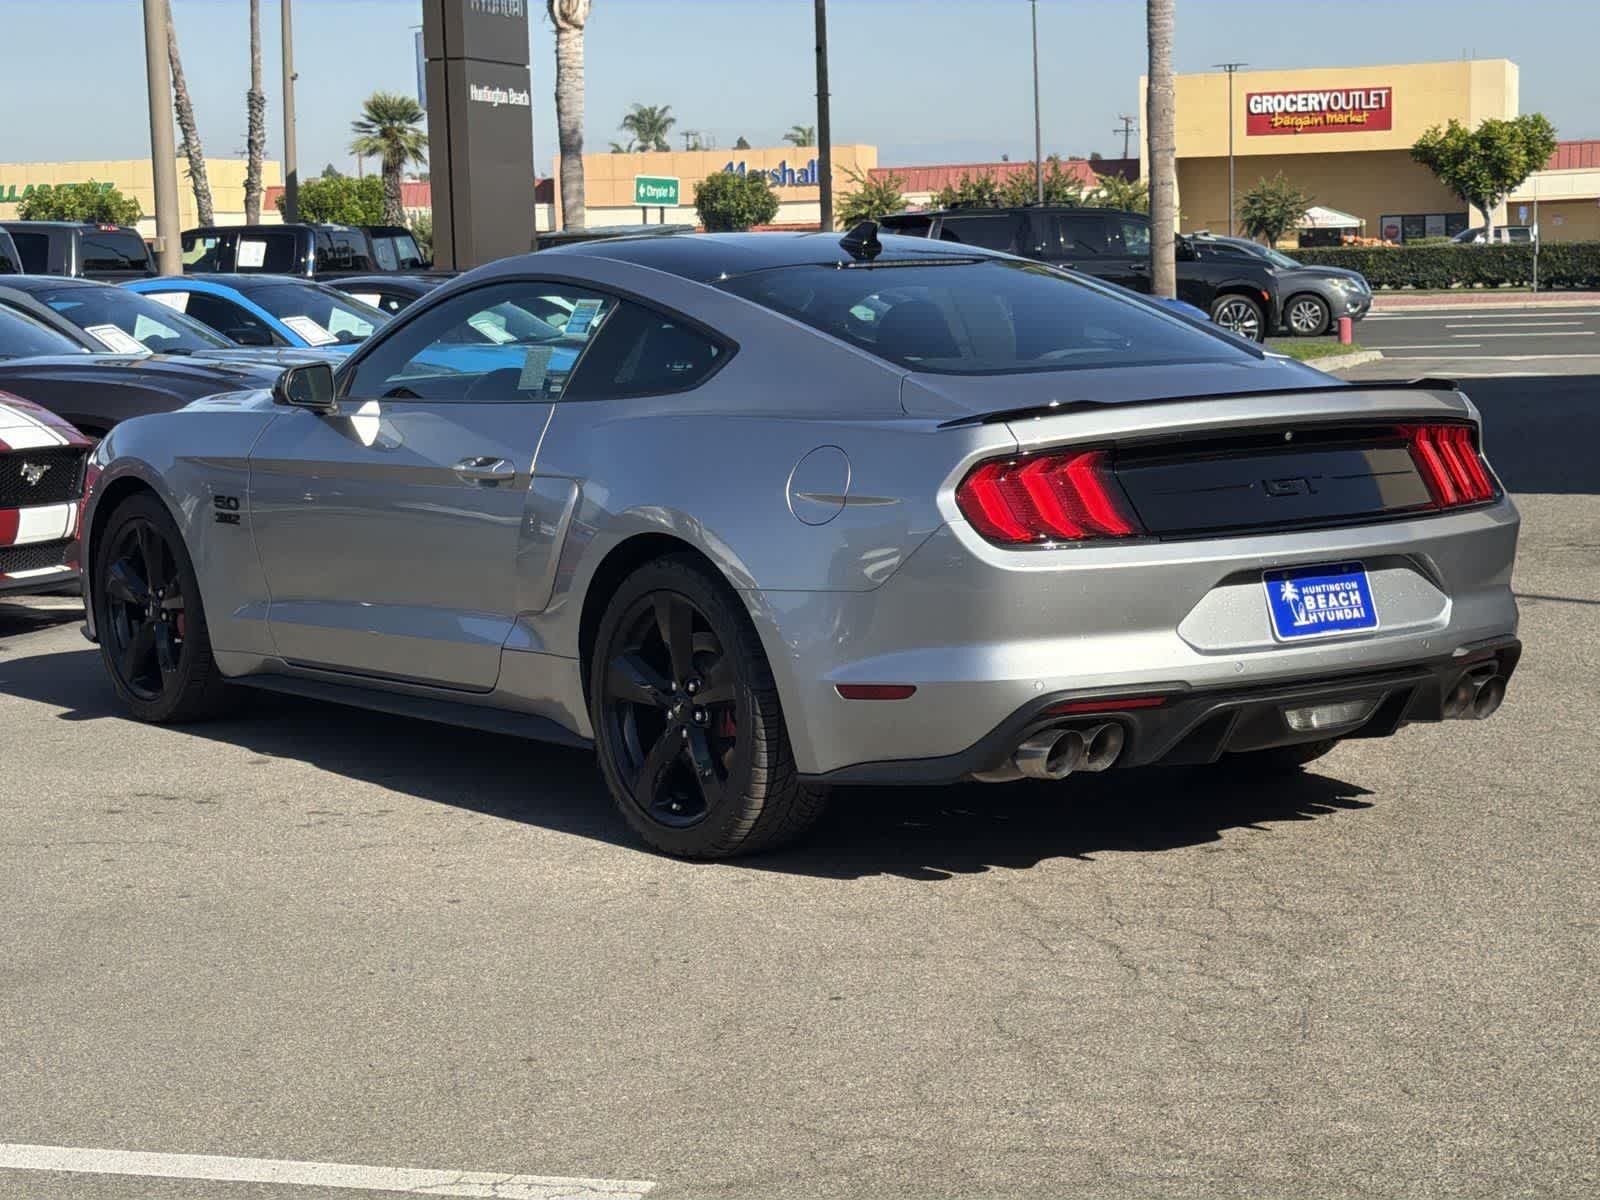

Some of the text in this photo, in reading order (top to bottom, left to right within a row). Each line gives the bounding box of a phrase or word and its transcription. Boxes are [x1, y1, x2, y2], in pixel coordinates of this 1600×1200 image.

[470, 83, 530, 107] Huntington Beach
[1270, 109, 1369, 131] bargain market
[1302, 581, 1358, 595] HUNTINGTON
[1304, 590, 1361, 610] BEACH
[1308, 607, 1366, 624] HYUNDAI
